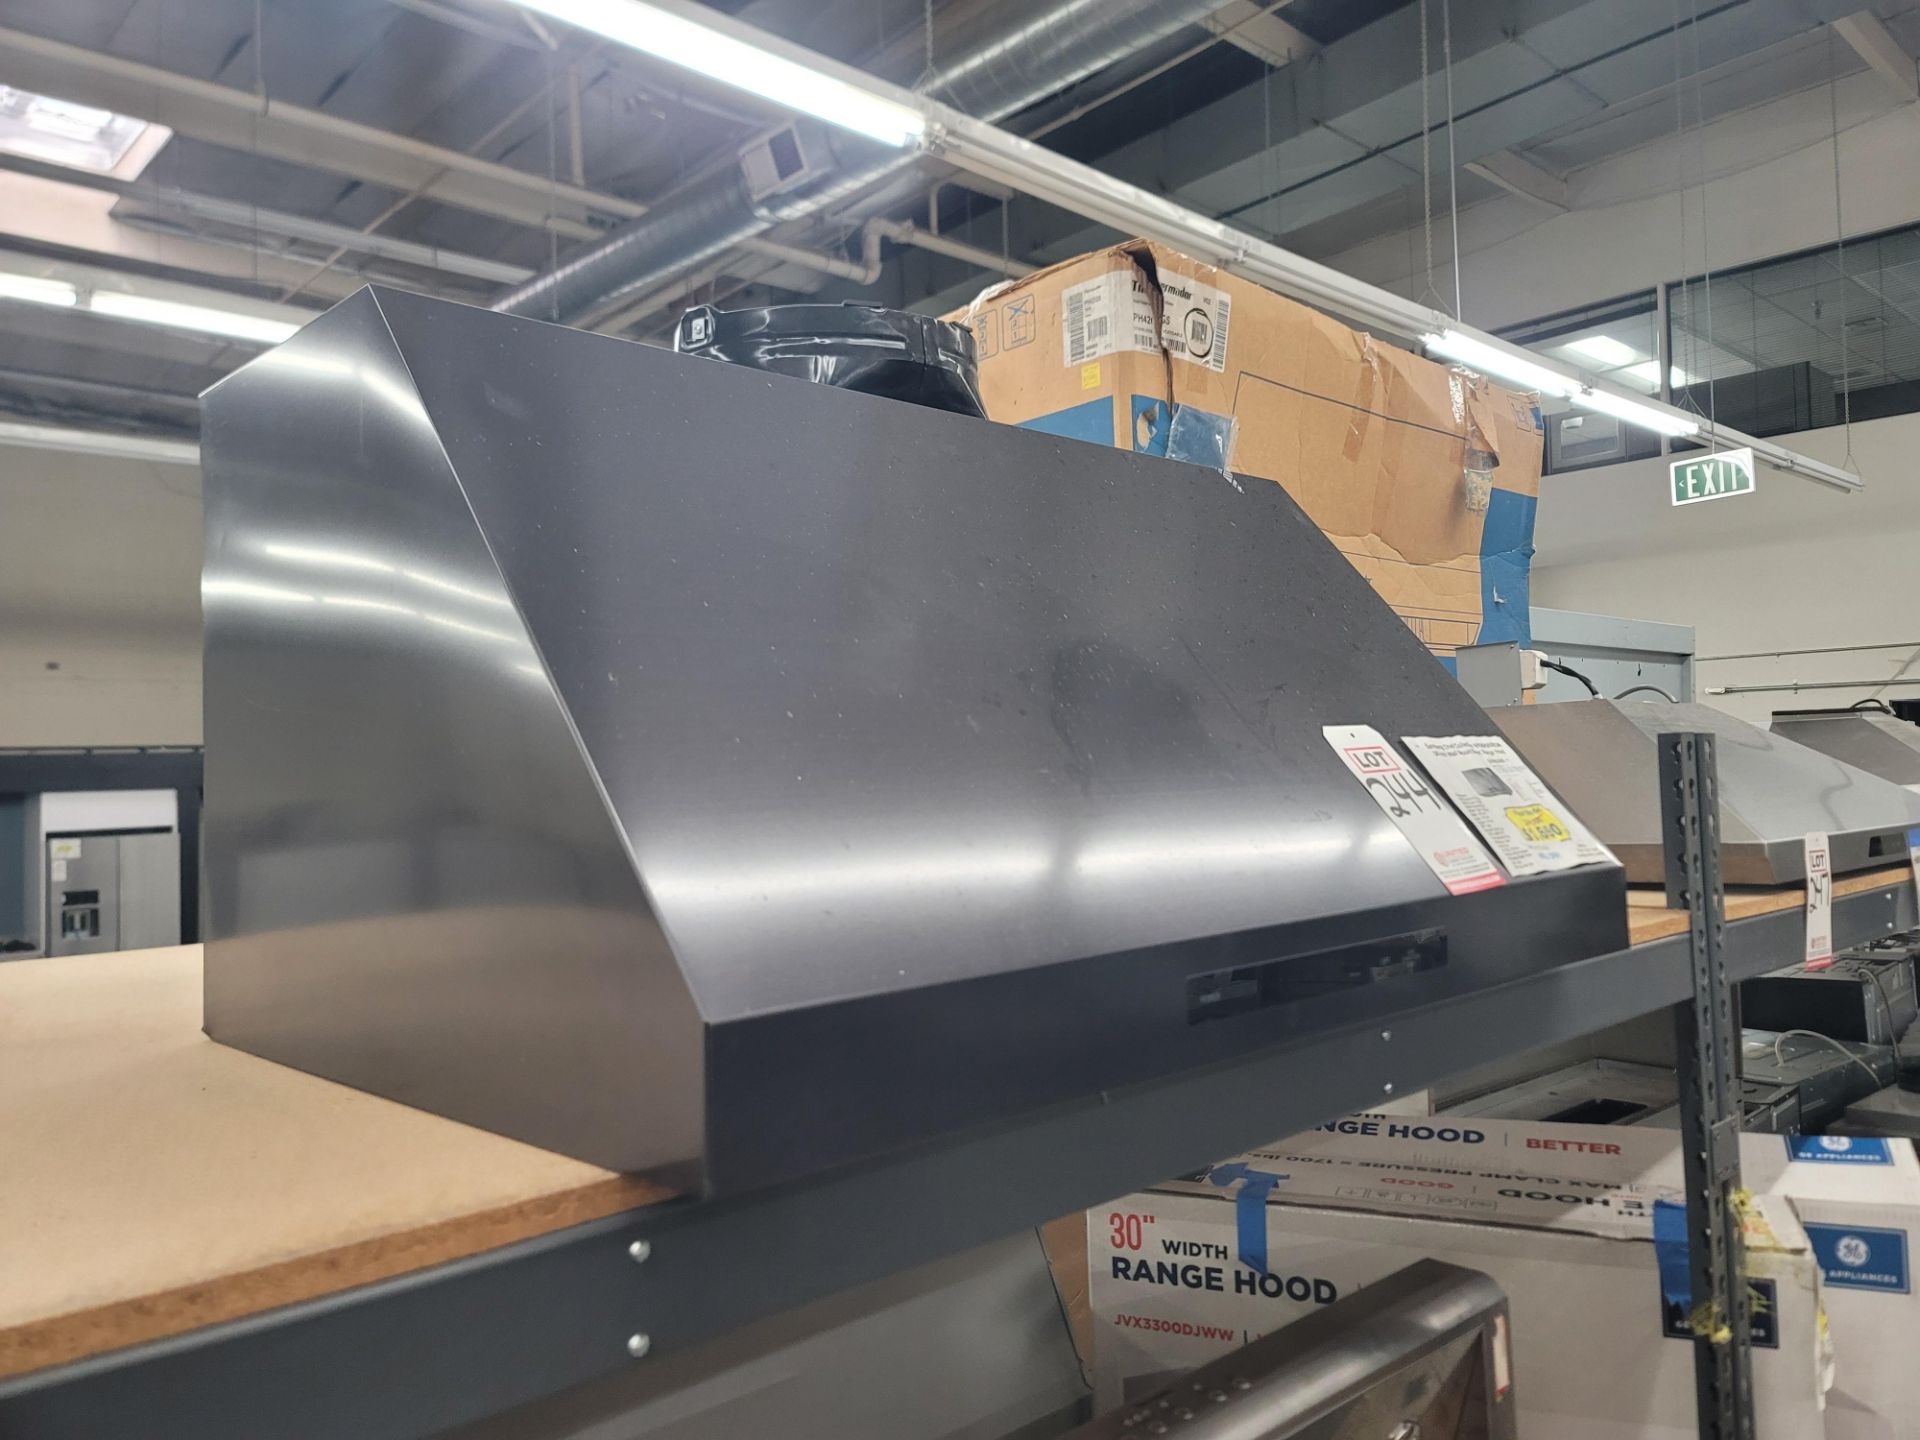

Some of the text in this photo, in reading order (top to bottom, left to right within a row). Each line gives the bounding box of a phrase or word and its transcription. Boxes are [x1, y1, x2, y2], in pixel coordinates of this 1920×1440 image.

[1686, 462, 1737, 498] EXIT
[1352, 750, 1390, 769] LOT
[1365, 769, 1441, 818] 244
[1811, 854, 1825, 869] LOT
[1808, 872, 1829, 914] 247
[1388, 1124, 1485, 1144] HOOD
[1526, 1138, 1623, 1156] BETTER
[1358, 1161, 1473, 1176] PRESSURE
[1479, 1170, 1560, 1185] CLAMP
[1380, 1177, 1455, 1189] GOOD
[1569, 1178, 1622, 1190] MAX
[1497, 1188, 1610, 1208] HOOD
[1109, 1212, 1229, 1261] 30" WIDTH
[1111, 1255, 1338, 1305] RANGE HOOD
[1829, 1269, 1898, 1284] APPLIANCES
[1114, 1313, 1235, 1342] JVX3300DJWW
